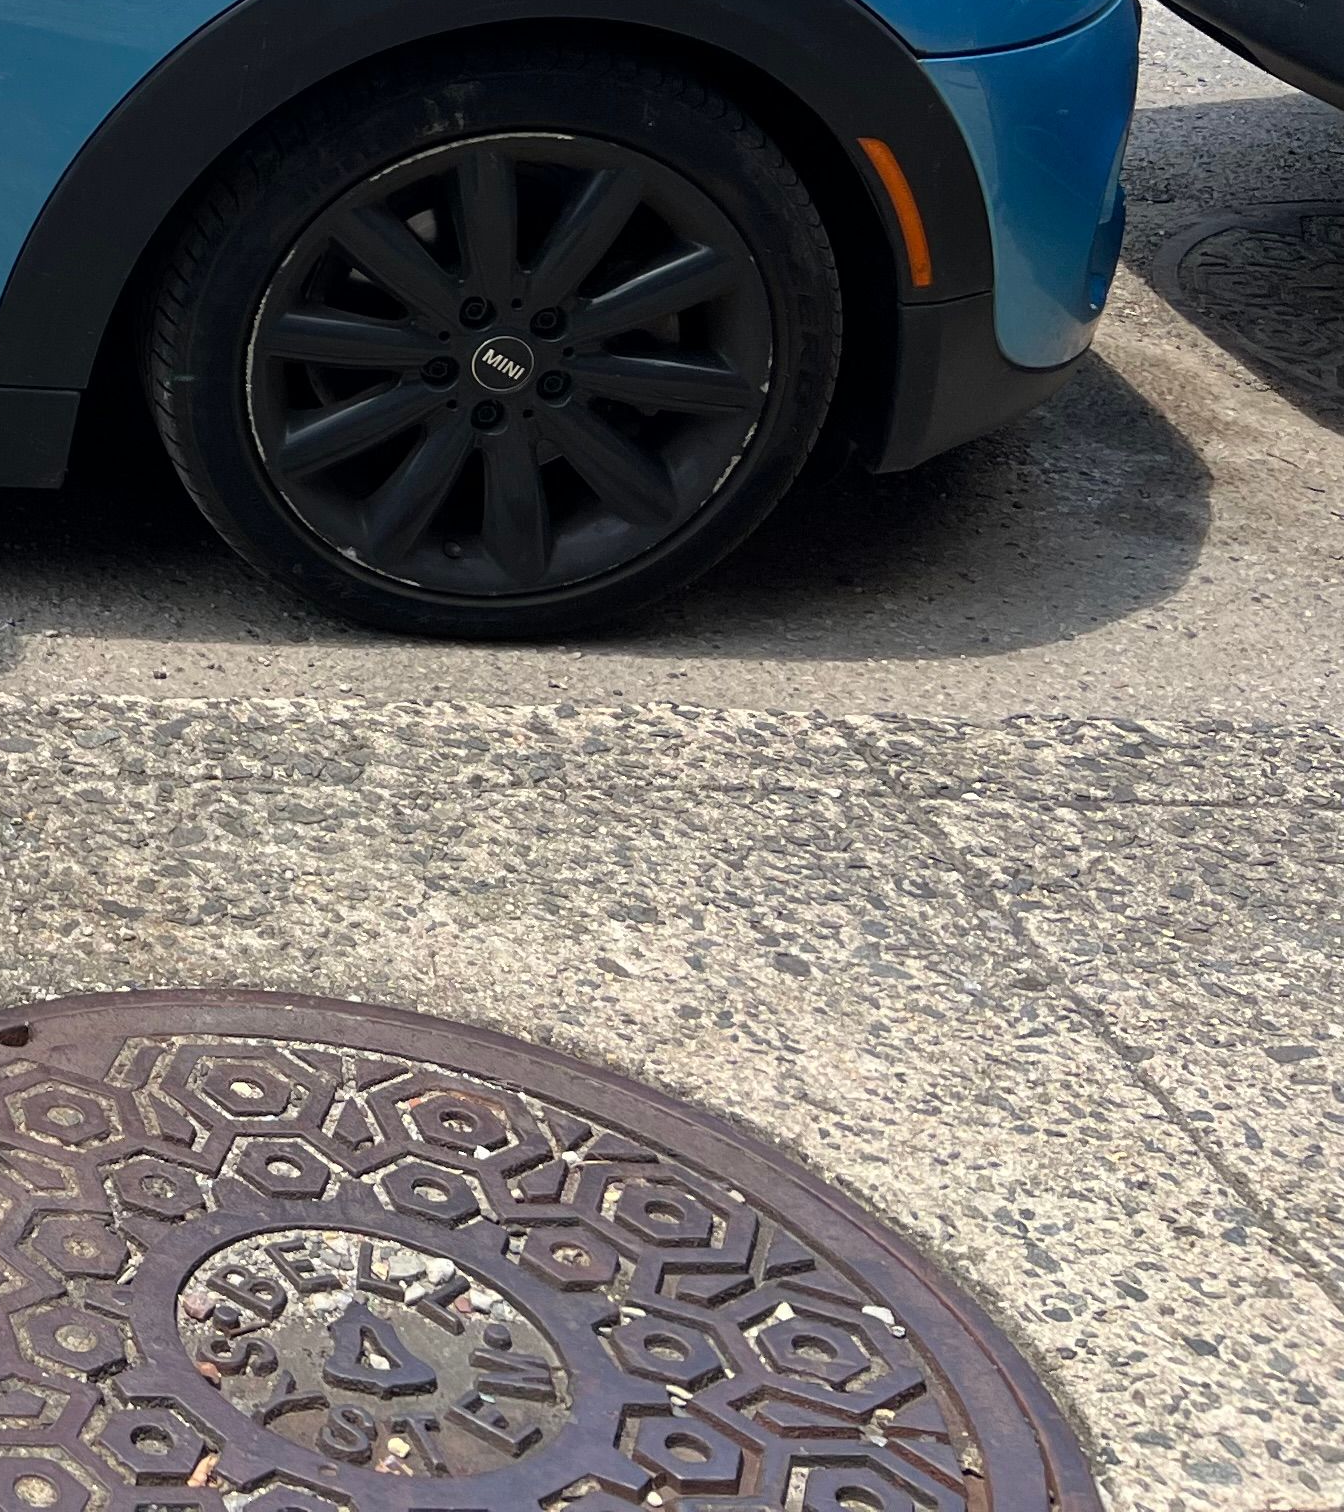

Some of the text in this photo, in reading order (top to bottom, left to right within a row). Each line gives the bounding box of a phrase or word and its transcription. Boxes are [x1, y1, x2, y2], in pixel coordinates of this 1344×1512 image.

[481, 348, 526, 380] MINI
[207, 1236, 473, 1336] BELL
[197, 1337, 559, 1478] SYSTEM
